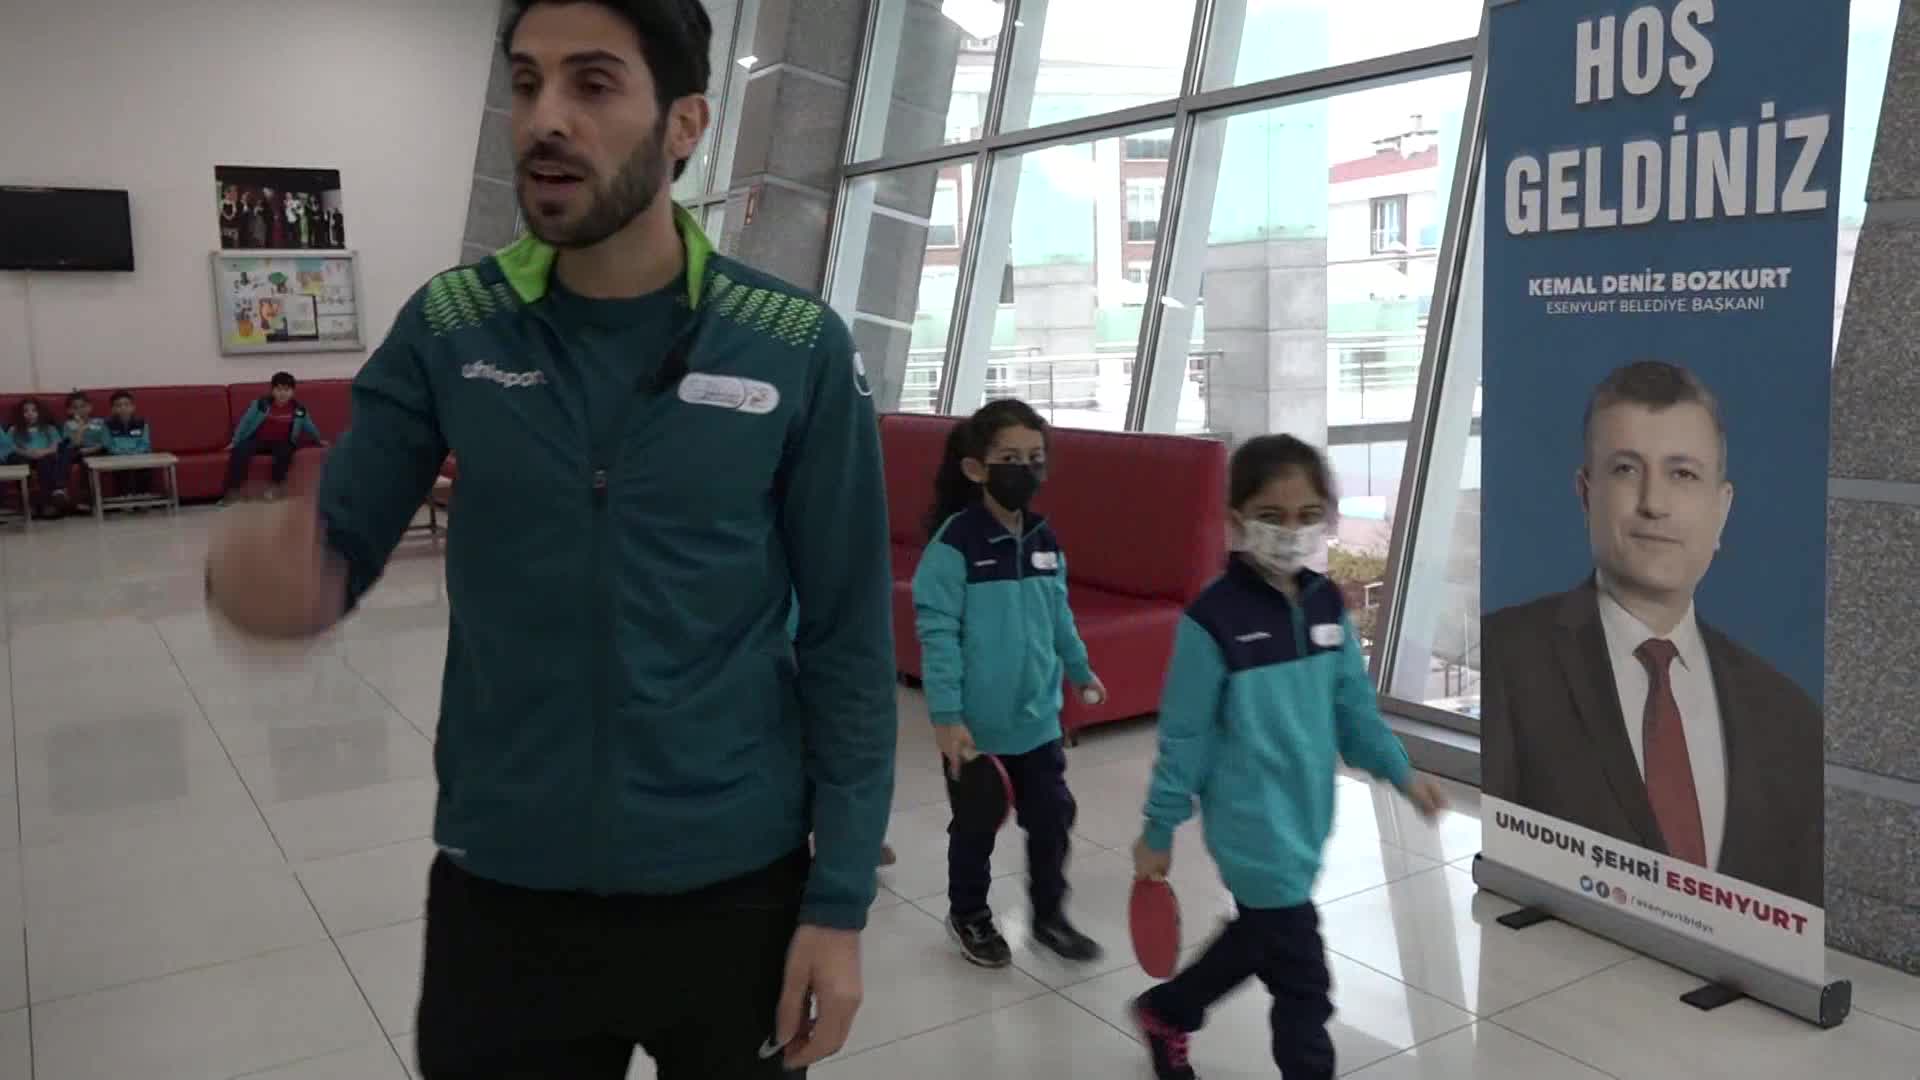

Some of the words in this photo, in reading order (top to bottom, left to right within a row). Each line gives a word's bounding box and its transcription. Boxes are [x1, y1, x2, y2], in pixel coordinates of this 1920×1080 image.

[1575, 0, 1715, 104] HOŞ
[1504, 101, 1830, 235] GELDİNİZ
[1528, 276, 1597, 297] KEMAL
[1602, 268, 1666, 294] DENİZ
[1672, 267, 1792, 292] BOZKURT
[1546, 299, 1615, 315] ESENYURT
[1620, 295, 1687, 313] BELEDİYE
[1495, 810, 1585, 857] UMUDUN
[1591, 845, 1659, 884] ŞEHRİ
[1666, 870, 1808, 936] ESENYURT
